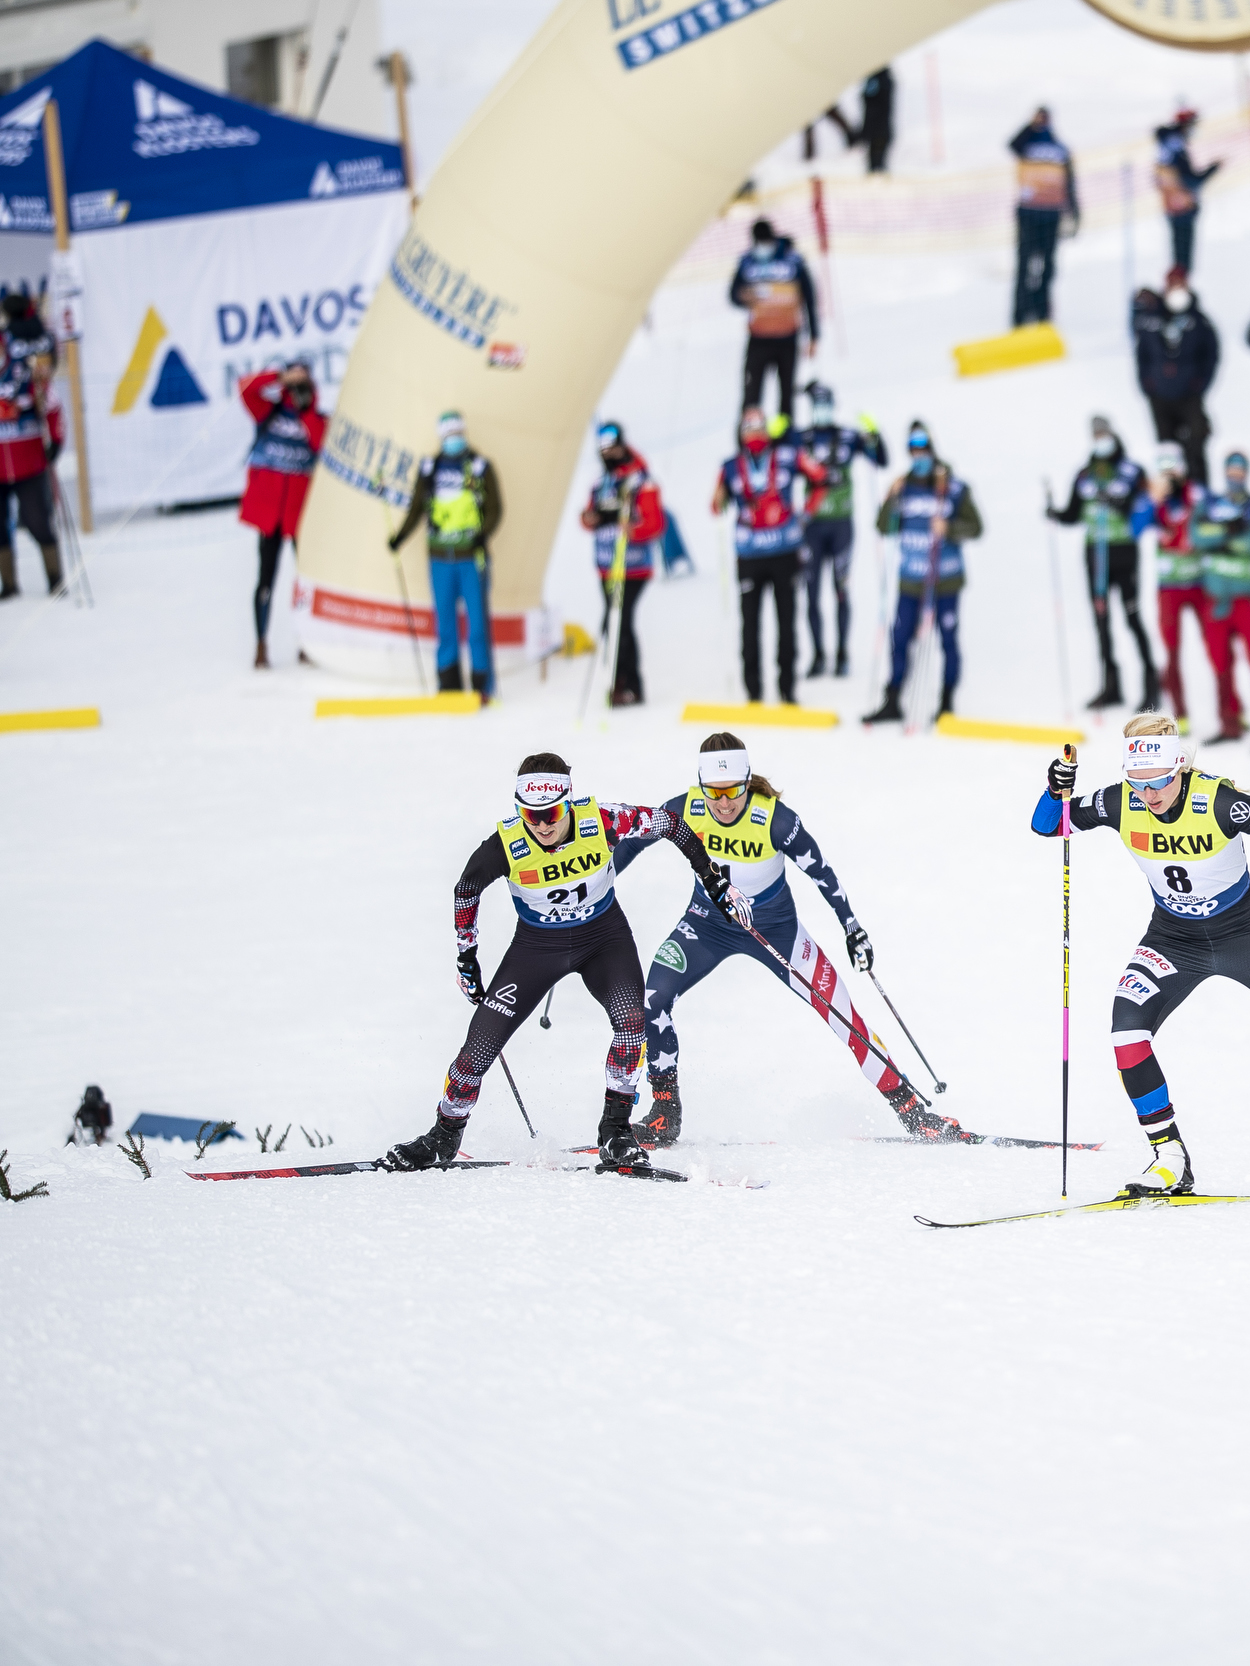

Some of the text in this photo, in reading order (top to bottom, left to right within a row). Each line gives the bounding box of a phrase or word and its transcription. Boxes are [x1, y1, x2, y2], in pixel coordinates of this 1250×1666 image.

[1138, 741, 1161, 753] ČPP
[525, 781, 564, 793] Seefeld
[1192, 804, 1207, 812] coop
[751, 815, 766, 823] coop
[580, 827, 598, 837] coop
[512, 847, 530, 858] coop
[708, 833, 763, 858] BKW
[1152, 833, 1214, 855] BKW
[542, 853, 601, 882] BKW
[1163, 865, 1193, 894] 8
[547, 882, 588, 905] 21
[1162, 899, 1219, 917] coop
[817, 958, 832, 993] xfinity
[1125, 976, 1151, 994] ČPP
[483, 996, 517, 1018] Löffler
